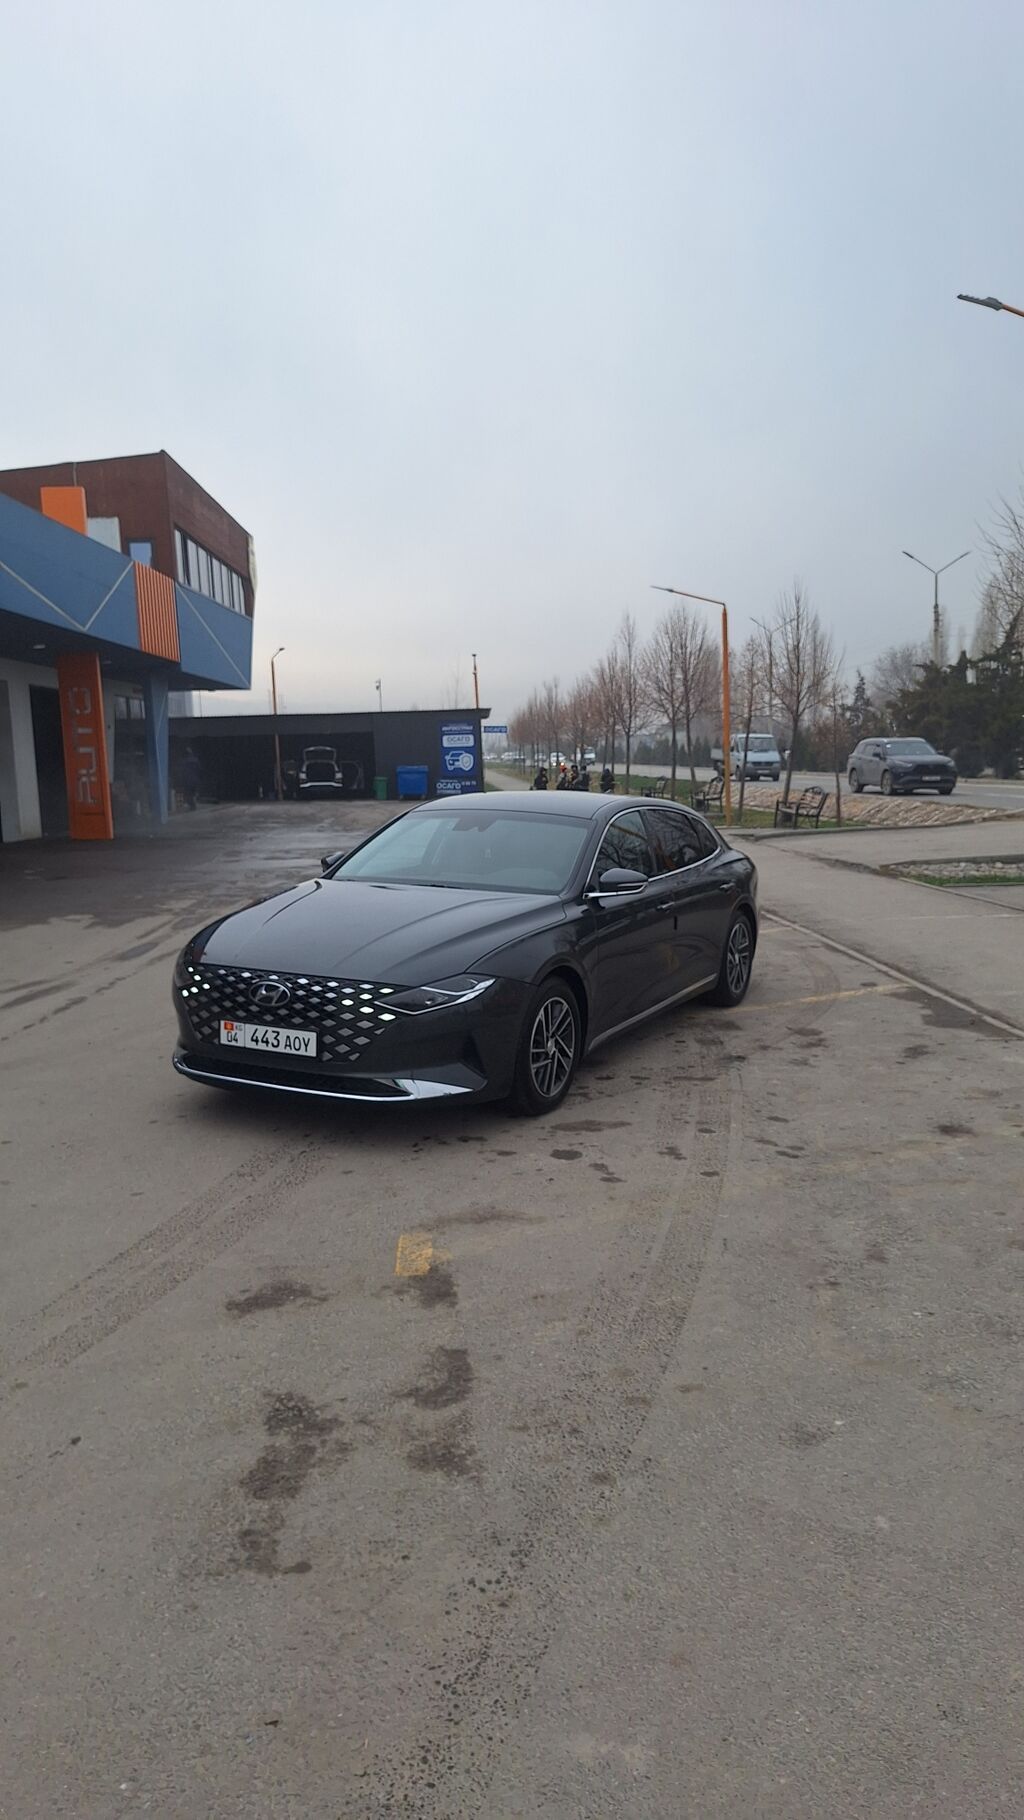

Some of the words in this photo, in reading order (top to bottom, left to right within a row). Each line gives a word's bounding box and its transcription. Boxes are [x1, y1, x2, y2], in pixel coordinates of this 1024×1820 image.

[227, 1031, 238, 1043] 04
[251, 1028, 280, 1048] 443
[284, 1035, 310, 1052] AOY
